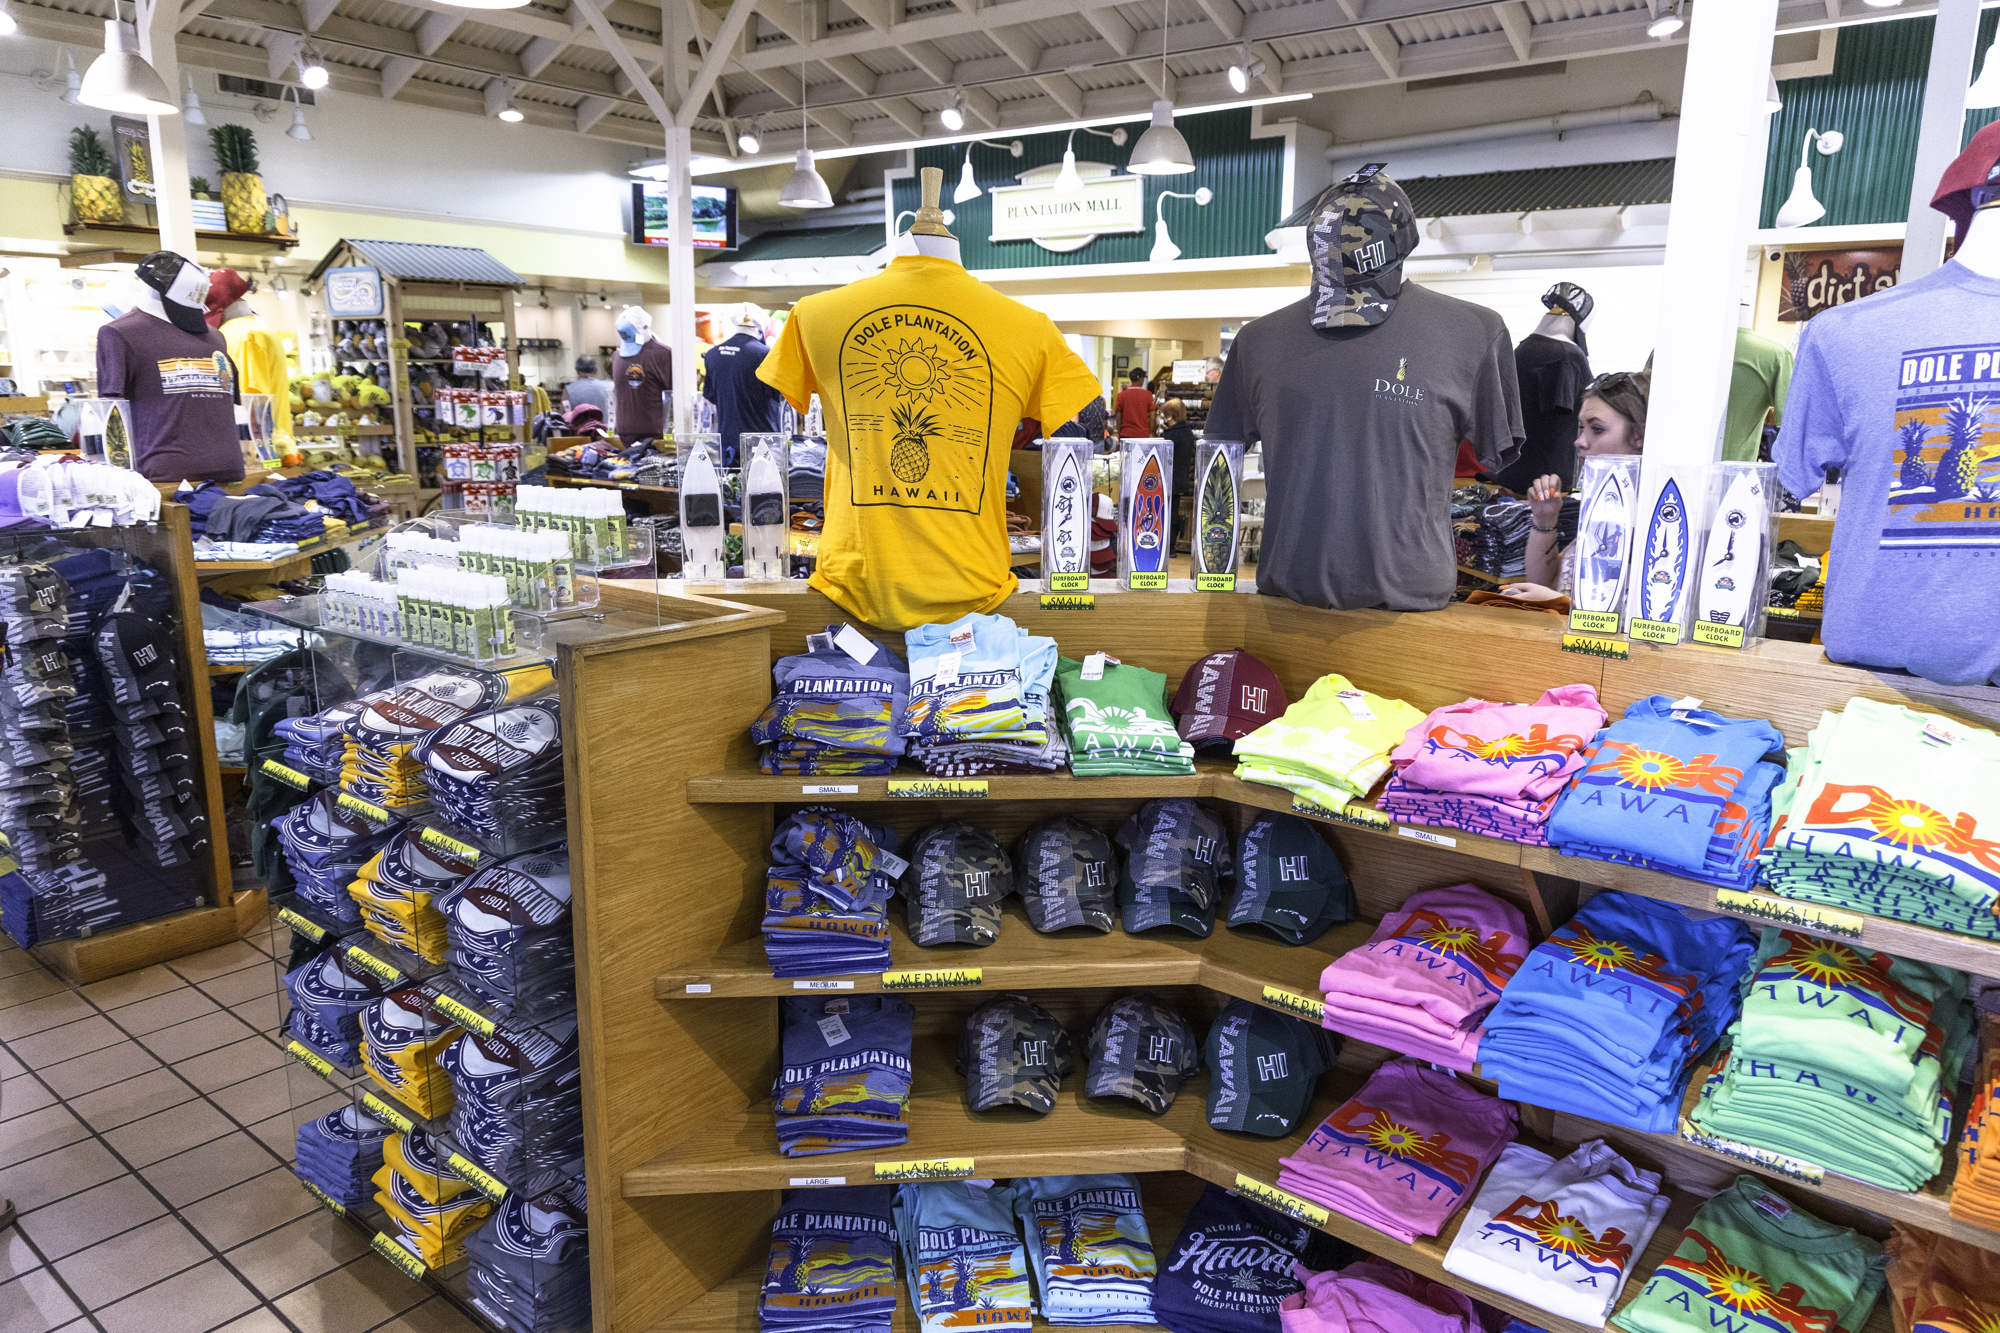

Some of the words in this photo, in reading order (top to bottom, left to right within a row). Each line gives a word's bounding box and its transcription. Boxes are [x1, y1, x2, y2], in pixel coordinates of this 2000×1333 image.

[1007, 200, 1081, 219] PLANTATION
[1086, 197, 1122, 212] MALL
[1313, 210, 1340, 327] HAWAII
[1353, 240, 1387, 275] HI
[1806, 264, 1866, 308] dirt
[854, 316, 893, 347] DOLE
[894, 313, 978, 362] PLANTATION
[1901, 354, 1964, 386] DOLE
[1373, 378, 1425, 402] DOLE
[873, 485, 960, 502] HAWAII
[1050, 596, 1084, 607] SMALL
[1573, 613, 1616, 623] SURFBOARD
[1582, 620, 1605, 629] CLOCK
[1633, 622, 1678, 633] SURFBOARD
[1696, 624, 1741, 637] SURFBOARD
[1574, 638, 1614, 653] SMALL
[1642, 630, 1666, 640] CLOCK
[1705, 633, 1729, 642] CLOCK
[99, 631, 130, 704] HAWAII
[793, 679, 894, 694] PLANTATION
[1185, 653, 1234, 740] HAWAII
[1241, 684, 1268, 714] HI
[453, 752, 480, 769] 1901
[912, 782, 965, 793] SMALL
[1414, 831, 1439, 843] SMALL
[1194, 835, 1218, 865] HI
[1085, 861, 1106, 888] HI
[1279, 855, 1310, 882] HI
[918, 838, 952, 944] HAWAII
[964, 870, 990, 899] HI
[482, 893, 510, 912] 1901
[810, 981, 838, 989] MEDIUM
[978, 1008, 1005, 1108] HAWAII
[1023, 1040, 1048, 1067] HI
[1149, 1035, 1175, 1064] HI
[1210, 1015, 1248, 1125] HAWAII
[1256, 1052, 1289, 1082] HI
[1326, 1100, 1479, 1186] Dole
[901, 1161, 950, 1173] LARGE
[1257, 1184, 1307, 1214] LARGE
[919, 1230, 957, 1250] DOLE
[1168, 1231, 1300, 1280] HAWAI
[1192, 1279, 1222, 1300] DOLE
[1194, 1293, 1241, 1311] PINEAPPLE
